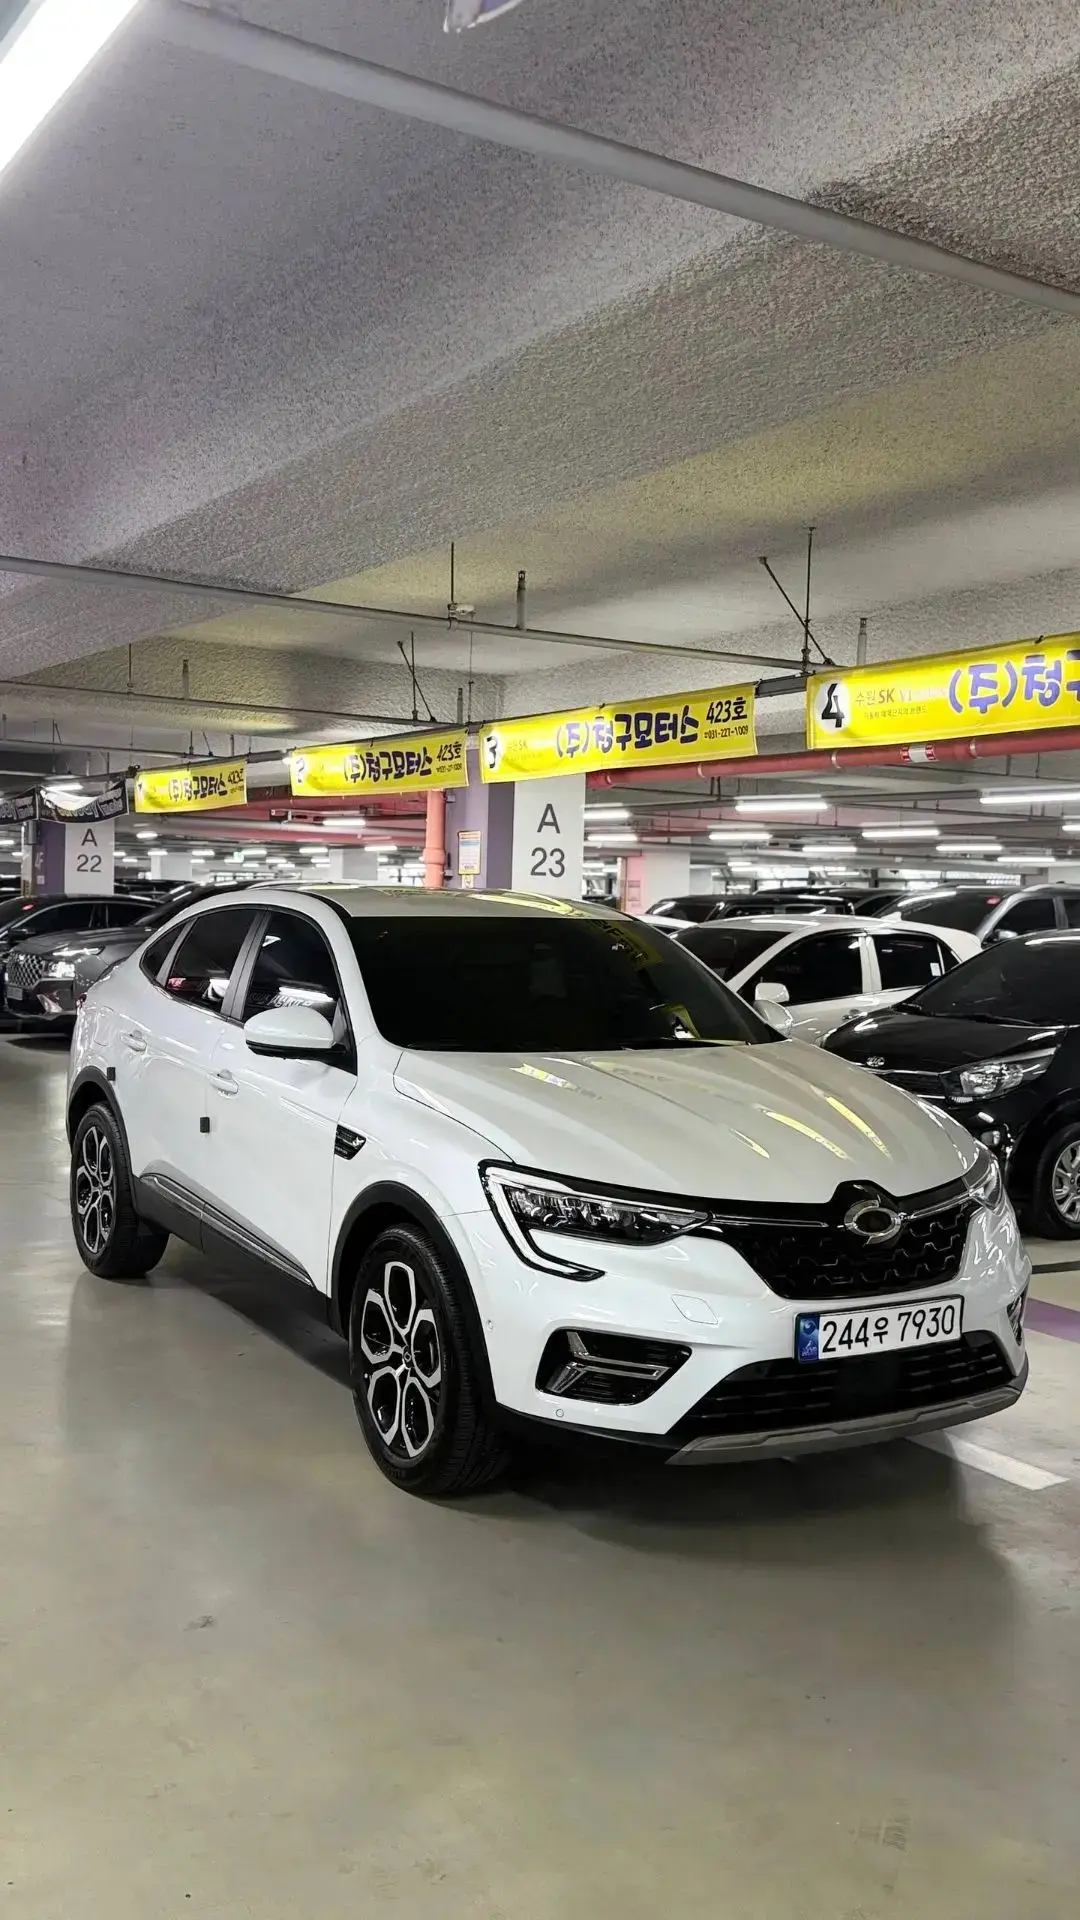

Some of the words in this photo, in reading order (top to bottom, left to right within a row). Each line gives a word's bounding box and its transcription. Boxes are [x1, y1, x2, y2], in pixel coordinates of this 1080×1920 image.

[821, 682, 845, 728] 4
[878, 688, 895, 704] SK
[556, 705, 699, 758] (주)청구모터스
[706, 697, 748, 724] 423호
[344, 747, 433, 783] (주)청구모터스
[436, 741, 462, 761] 423호
[486, 735, 498, 769] 3
[536, 803, 561, 834] A
[81, 828, 98, 847] A
[76, 855, 103, 873] 22
[530, 847, 566, 878] 23
[822, 1316, 889, 1353] 244우
[897, 1304, 955, 1342] 7930
